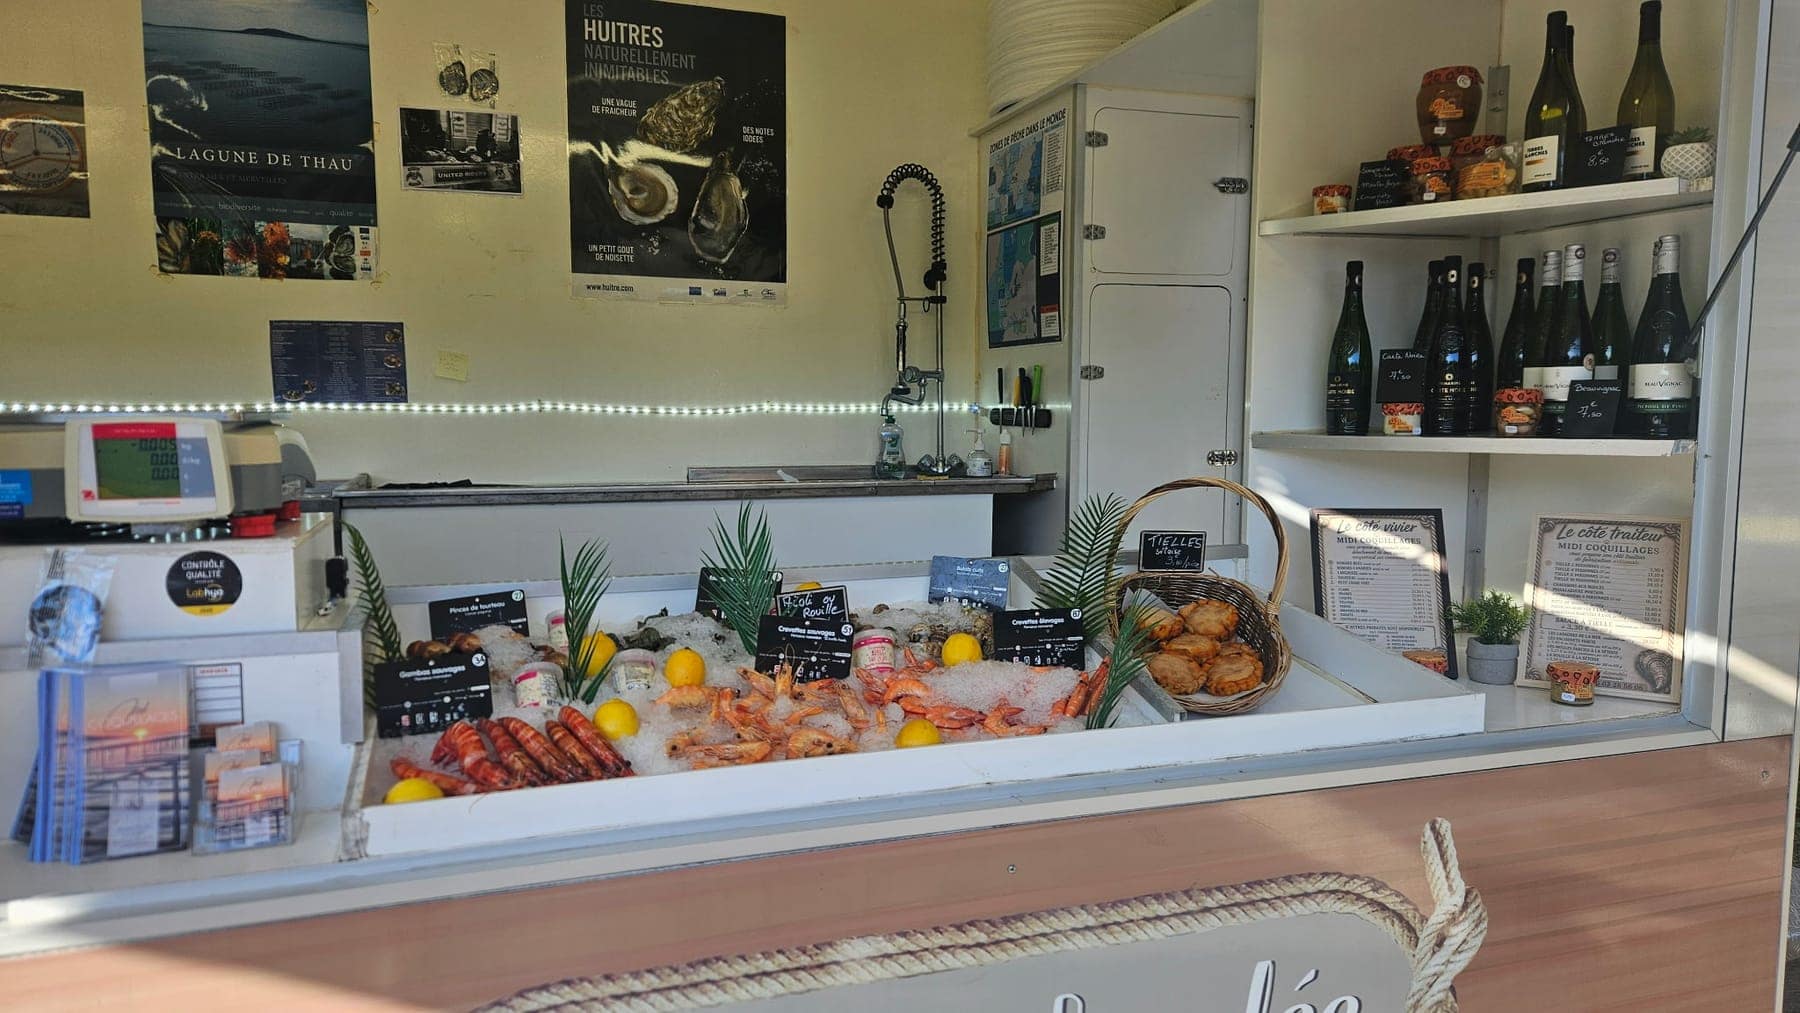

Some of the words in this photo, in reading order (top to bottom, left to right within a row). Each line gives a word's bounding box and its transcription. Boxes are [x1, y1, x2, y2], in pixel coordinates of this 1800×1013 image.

[584, 4, 604, 18] LES
[584, 18, 664, 48] HUITRES
[584, 44, 696, 70] NATURELLEMENT
[584, 62, 670, 85] INIMITABLES
[602, 98, 615, 106] UNE
[616, 99, 637, 109] VAGUE
[602, 106, 637, 117] FRAICHEUR
[742, 126, 755, 135] DES
[756, 128, 775, 136] NOTES
[990, 139, 1004, 154] ZONES
[1004, 136, 1010, 147] DE
[1026, 122, 1039, 137] DANS
[1040, 118, 1046, 130] LE
[1046, 108, 1066, 127] MONDE
[176, 147, 258, 165] LAGUNE
[267, 152, 292, 167] DE
[300, 156, 353, 171] THAU
[588, 244, 598, 253] UN
[599, 244, 616, 254] PETIT
[617, 246, 634, 254] GOUT
[596, 252, 604, 261] DE
[605, 254, 634, 263] NOISETTE
[586, 282, 634, 293] www.huitre.com
[1337, 520, 1352, 534] Le
[1356, 520, 1381, 533] côté
[1384, 522, 1418, 533] vivier
[1556, 524, 1575, 540] Le
[1578, 526, 1608, 539] côté
[1610, 526, 1666, 541] traiteur
[1148, 534, 1202, 548] TIELLES
[1360, 537, 1422, 545] COQUILLAGES
[1558, 542, 1582, 550] MIDI
[1585, 544, 1660, 555] COQUILLAGES
[182, 558, 225, 571] CONTRÔLE
[186, 568, 222, 580] QUALITÉ
[803, 602, 845, 618] Rouille
[1012, 618, 1038, 626] Crevettes
[778, 625, 806, 635] Crevettes
[807, 628, 835, 637] sauvages
[399, 669, 430, 678] Gambas
[432, 665, 466, 674] sauvages
